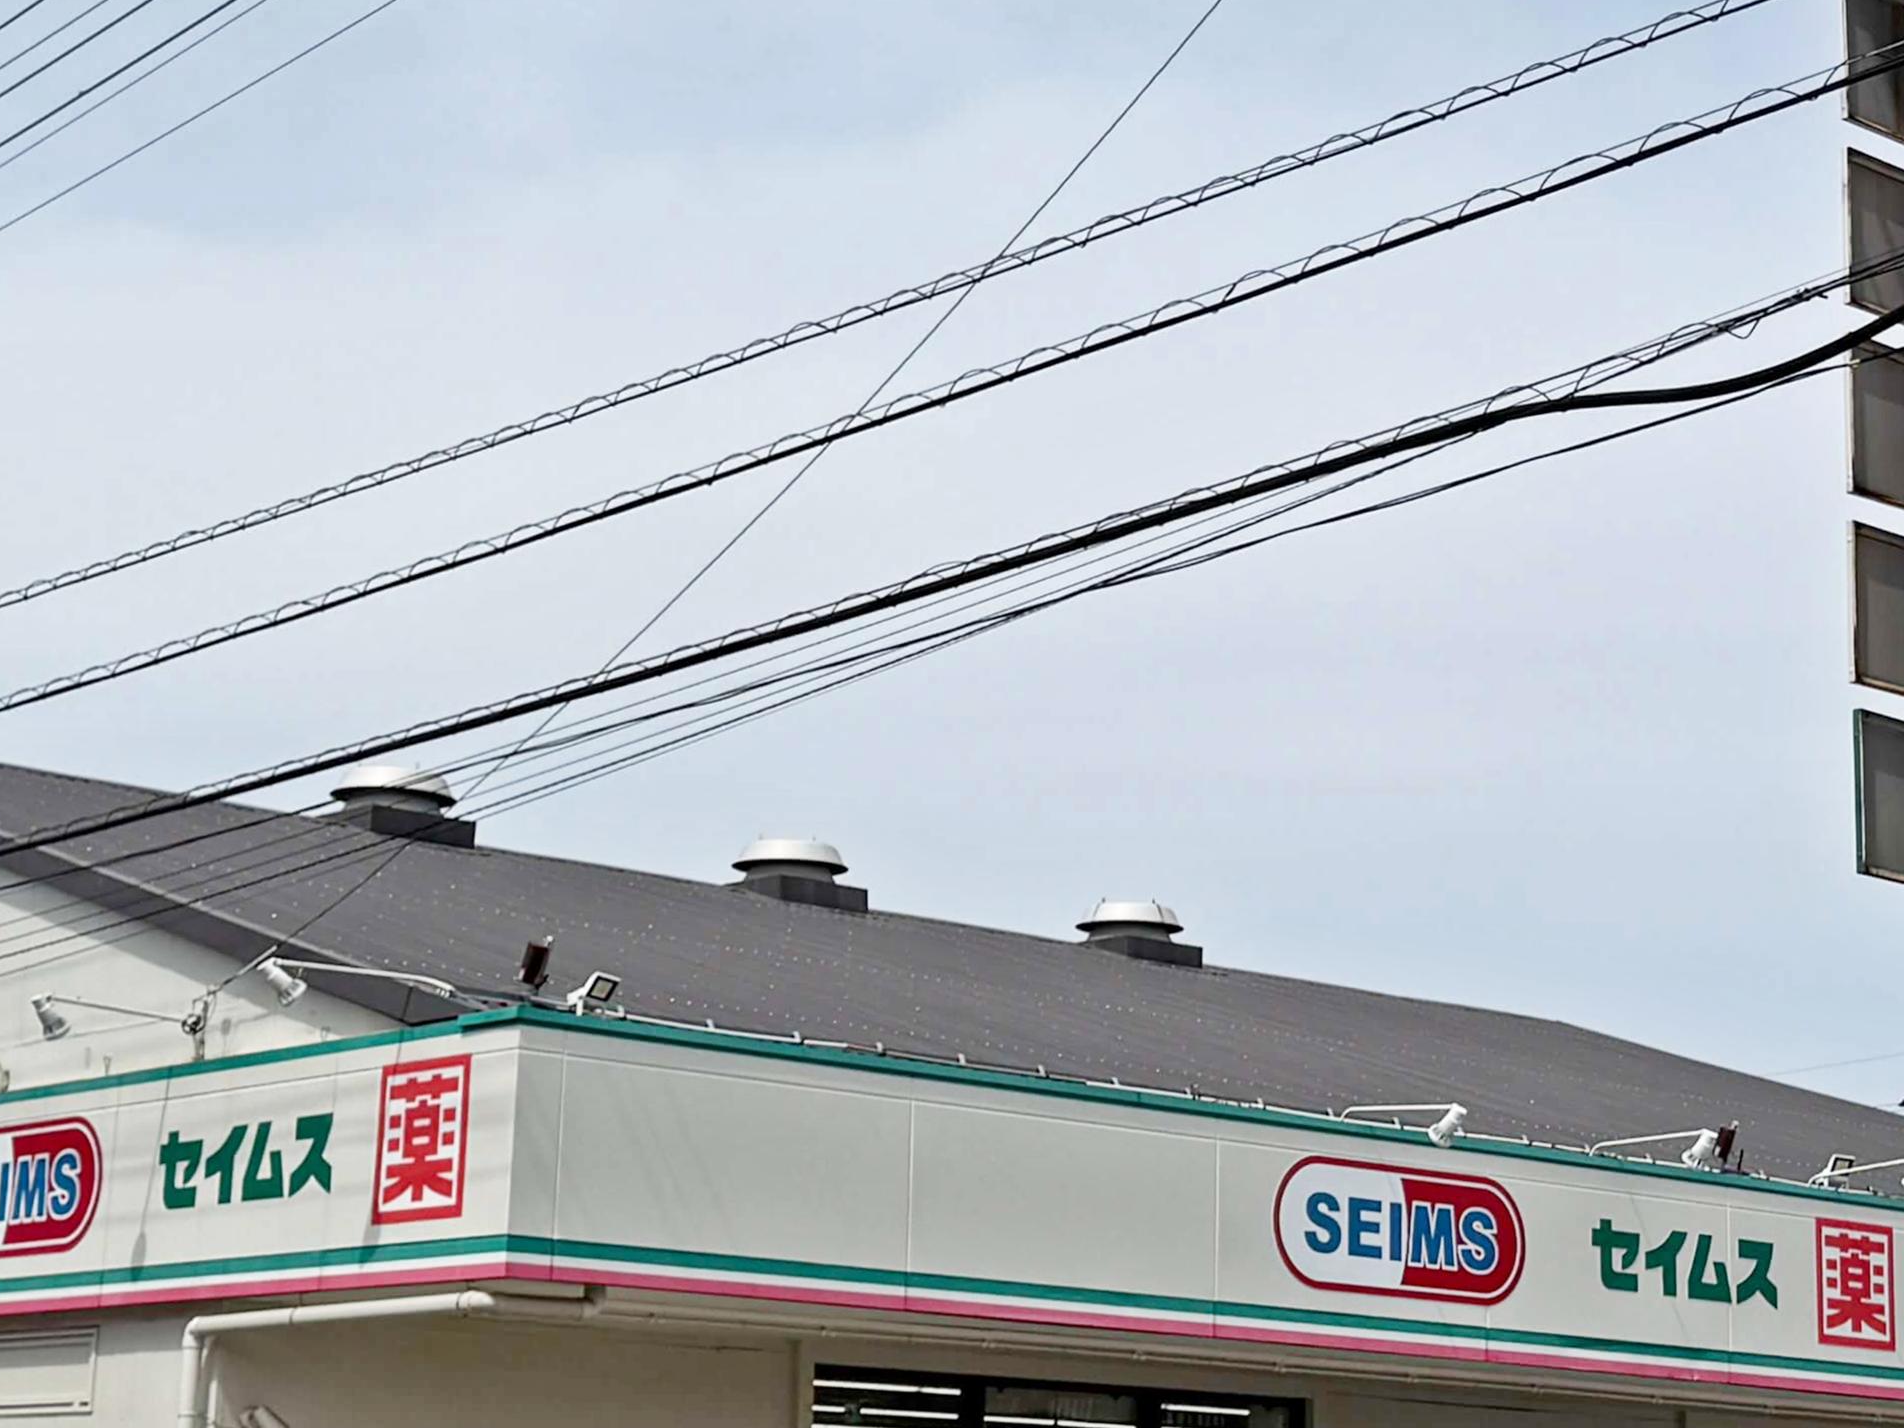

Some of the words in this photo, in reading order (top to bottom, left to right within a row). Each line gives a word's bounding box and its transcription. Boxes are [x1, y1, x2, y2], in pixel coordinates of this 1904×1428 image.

[159, 1112, 333, 1209] セイムス
[381, 1067, 460, 1204] 薬
[1303, 1191, 1500, 1273] SEIMS
[1591, 1218, 1778, 1309] セイムス
[1823, 1232, 1888, 1337] 薬
